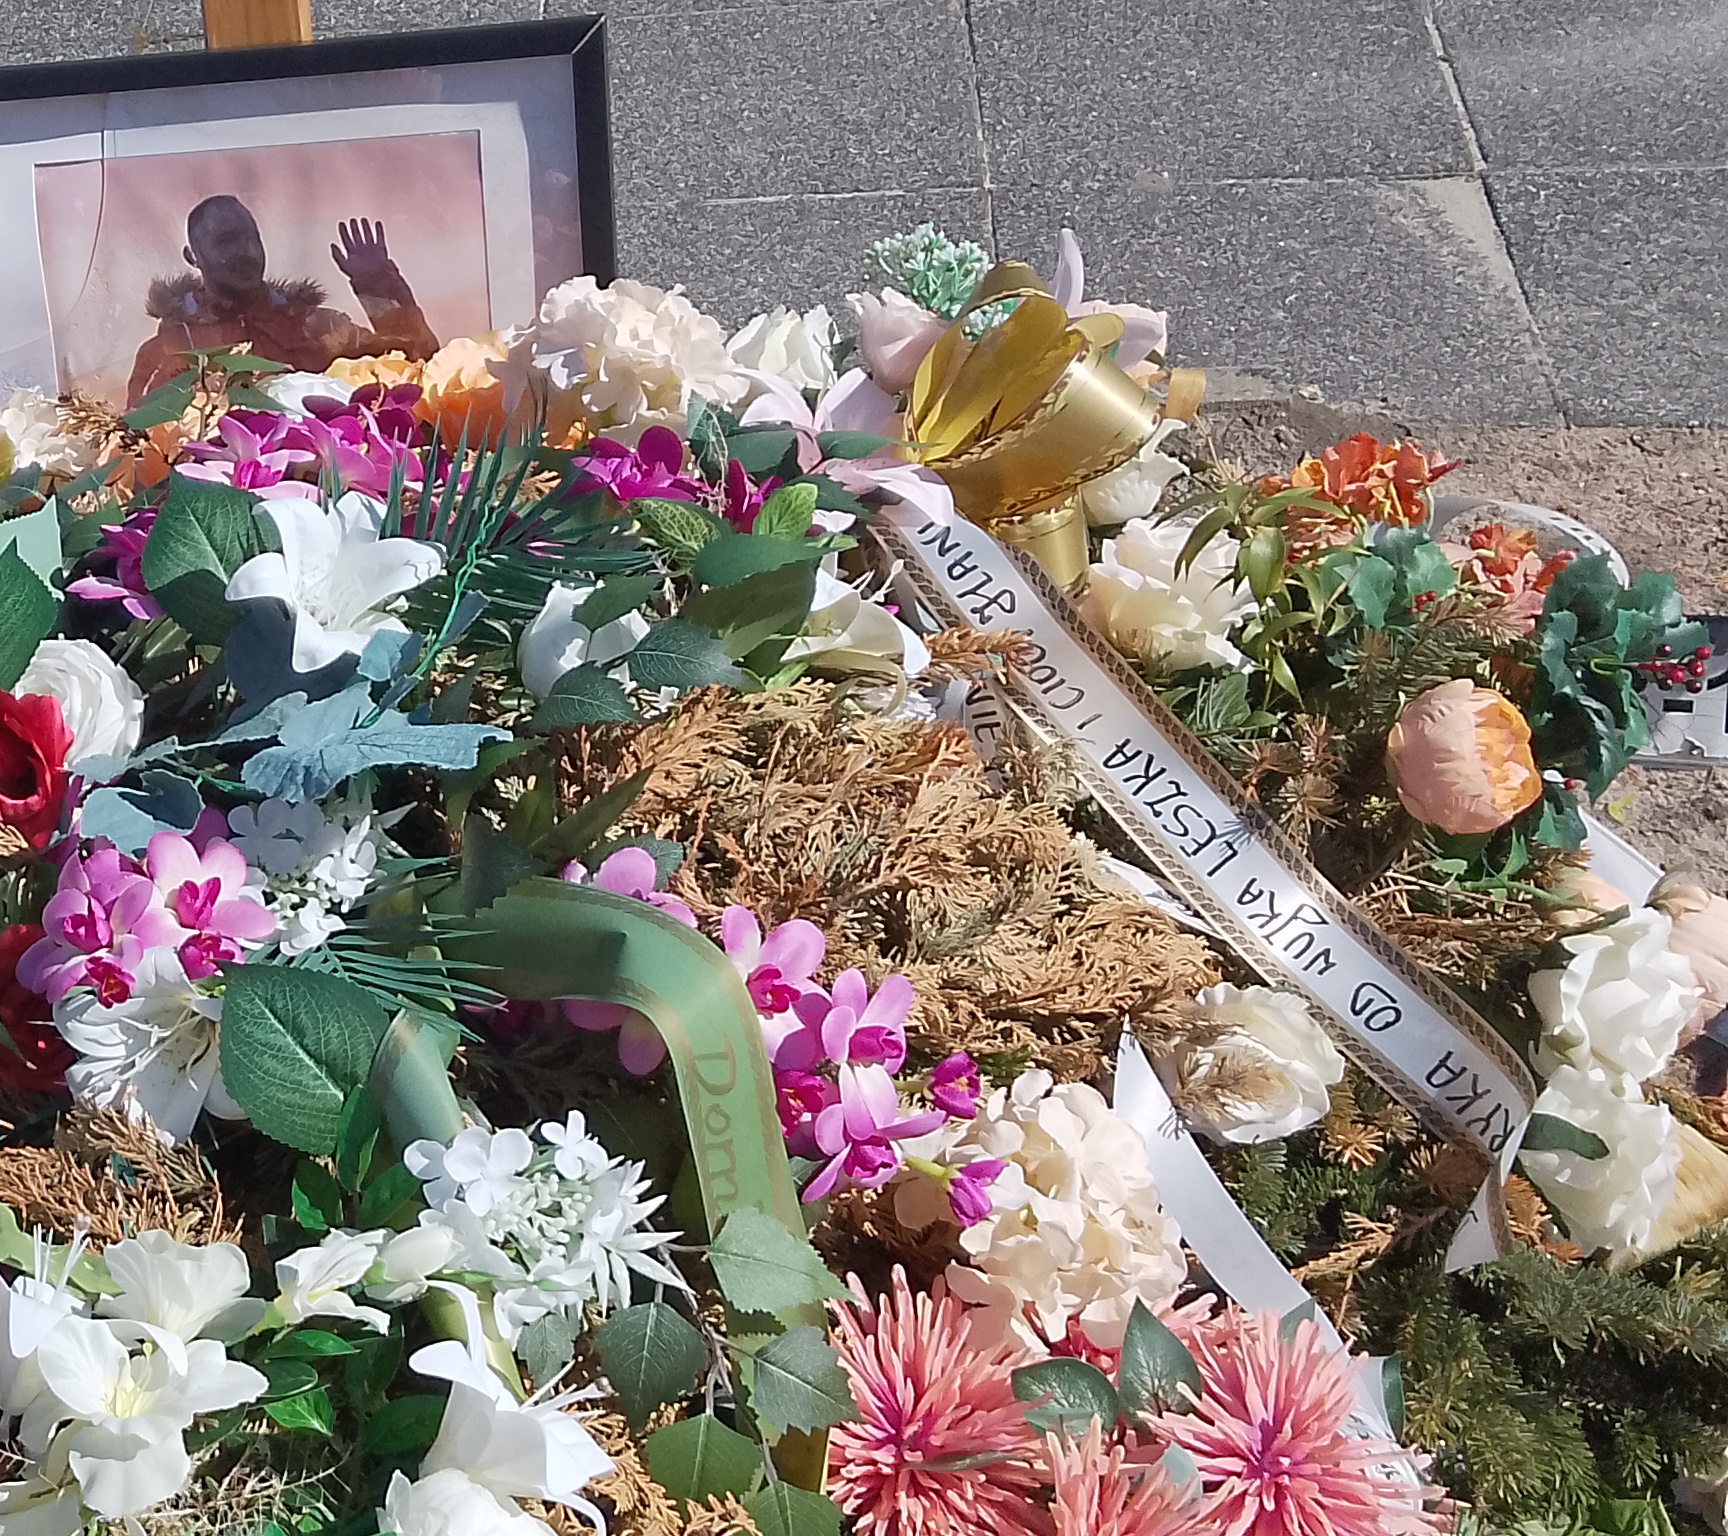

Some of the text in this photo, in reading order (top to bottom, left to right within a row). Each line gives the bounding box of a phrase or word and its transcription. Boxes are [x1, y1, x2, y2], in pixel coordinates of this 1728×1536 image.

[1101, 736, 1240, 878] LESZKA
[1236, 876, 1338, 978] WUJKA
[1348, 981, 1403, 1033] OD
[691, 1031, 764, 1214] Dom
